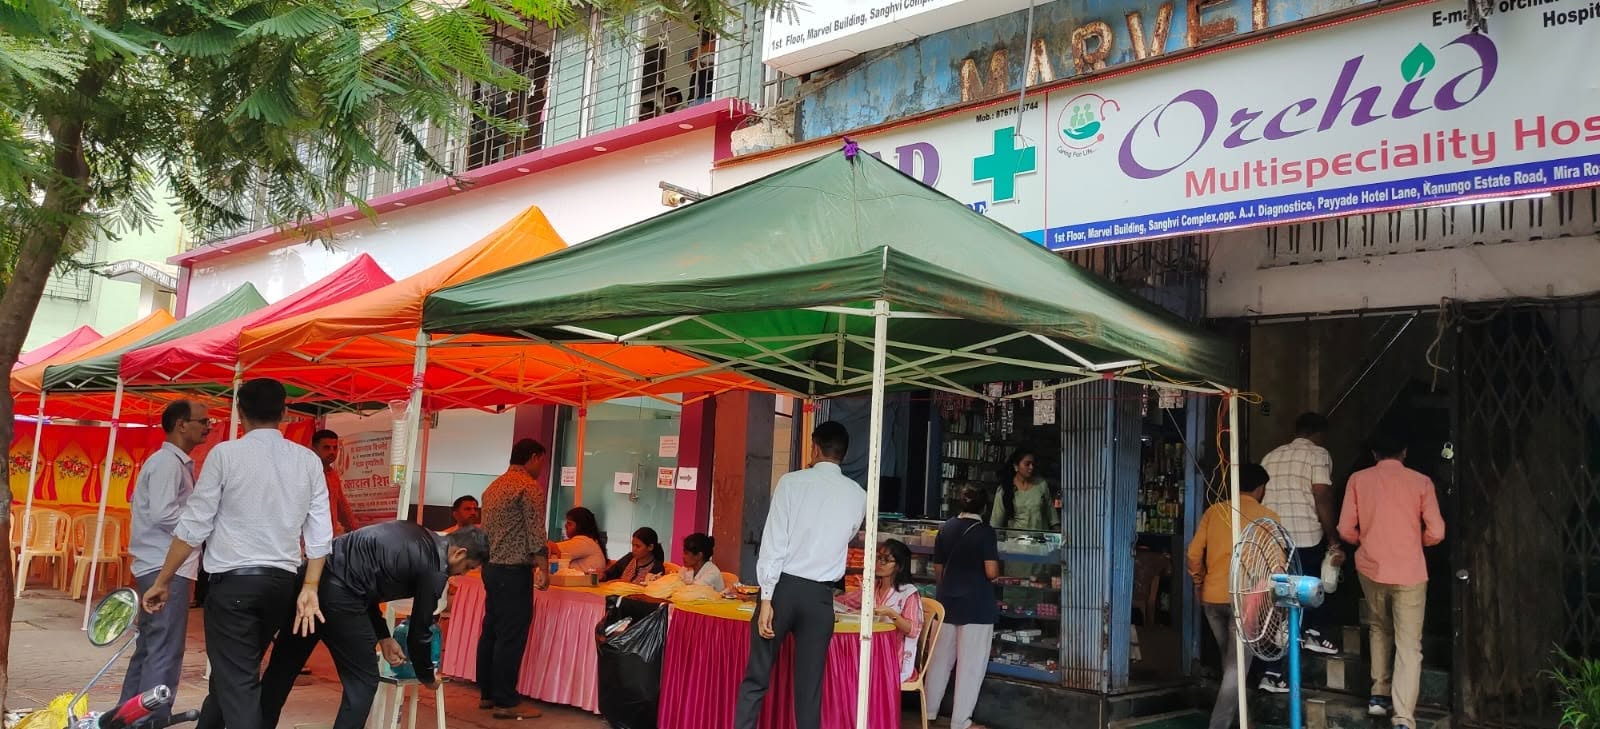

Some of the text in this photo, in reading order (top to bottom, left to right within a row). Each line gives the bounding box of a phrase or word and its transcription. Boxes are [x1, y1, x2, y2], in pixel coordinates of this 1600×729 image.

[772, 39, 783, 51] 1st
[785, 32, 806, 45] Floor,
[807, 22, 833, 40] Marvel
[834, 13, 868, 32] Building,
[869, 0, 903, 20] Sanghvi
[1118, 33, 1498, 180] Orchid
[1185, 128, 1496, 198] Multispeciality
[1054, 232, 1066, 243] 1st
[1066, 229, 1087, 243] Floor,
[1088, 226, 1112, 239] Marvel
[1114, 221, 1147, 235] Building,
[1148, 217, 1180, 233] Sanghvi
[1239, 207, 1257, 219] A.J.
[1258, 200, 1316, 217] Diagnostice,
[1317, 192, 1359, 211] Payyade
[1361, 188, 1389, 203] Hotel
[1391, 183, 1421, 200] Lane,
[1423, 180, 1472, 197] Kanungo
[1474, 175, 1511, 190] Estate
[1514, 170, 1548, 185] Road,
[1553, 165, 1580, 181] Mira
